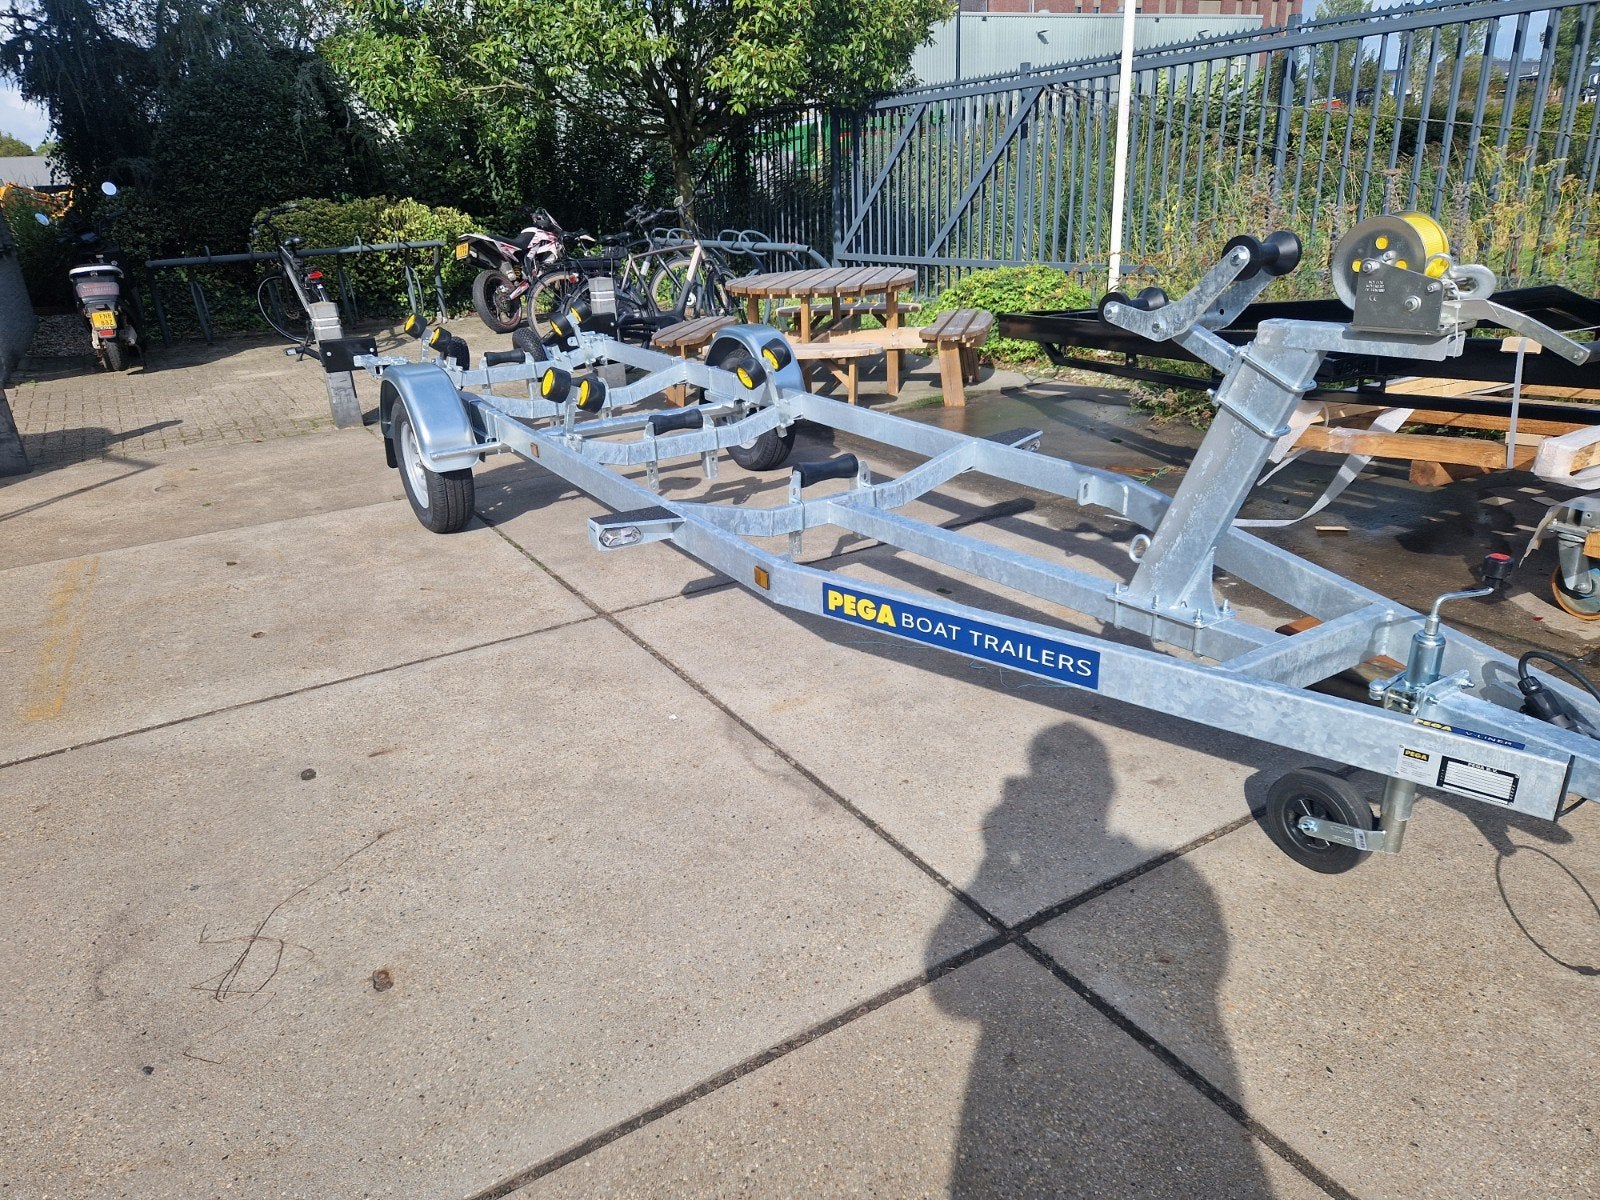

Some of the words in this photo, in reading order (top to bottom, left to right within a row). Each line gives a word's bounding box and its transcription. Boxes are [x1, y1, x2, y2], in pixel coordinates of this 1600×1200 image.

[827, 589, 897, 628] PEGA
[901, 612, 961, 641] BOAT
[969, 630, 1093, 677] TRAILERS
[1414, 719, 1452, 732] PEGA
[1465, 731, 1513, 746] V-LINER
[1404, 750, 1428, 761] PEGA
